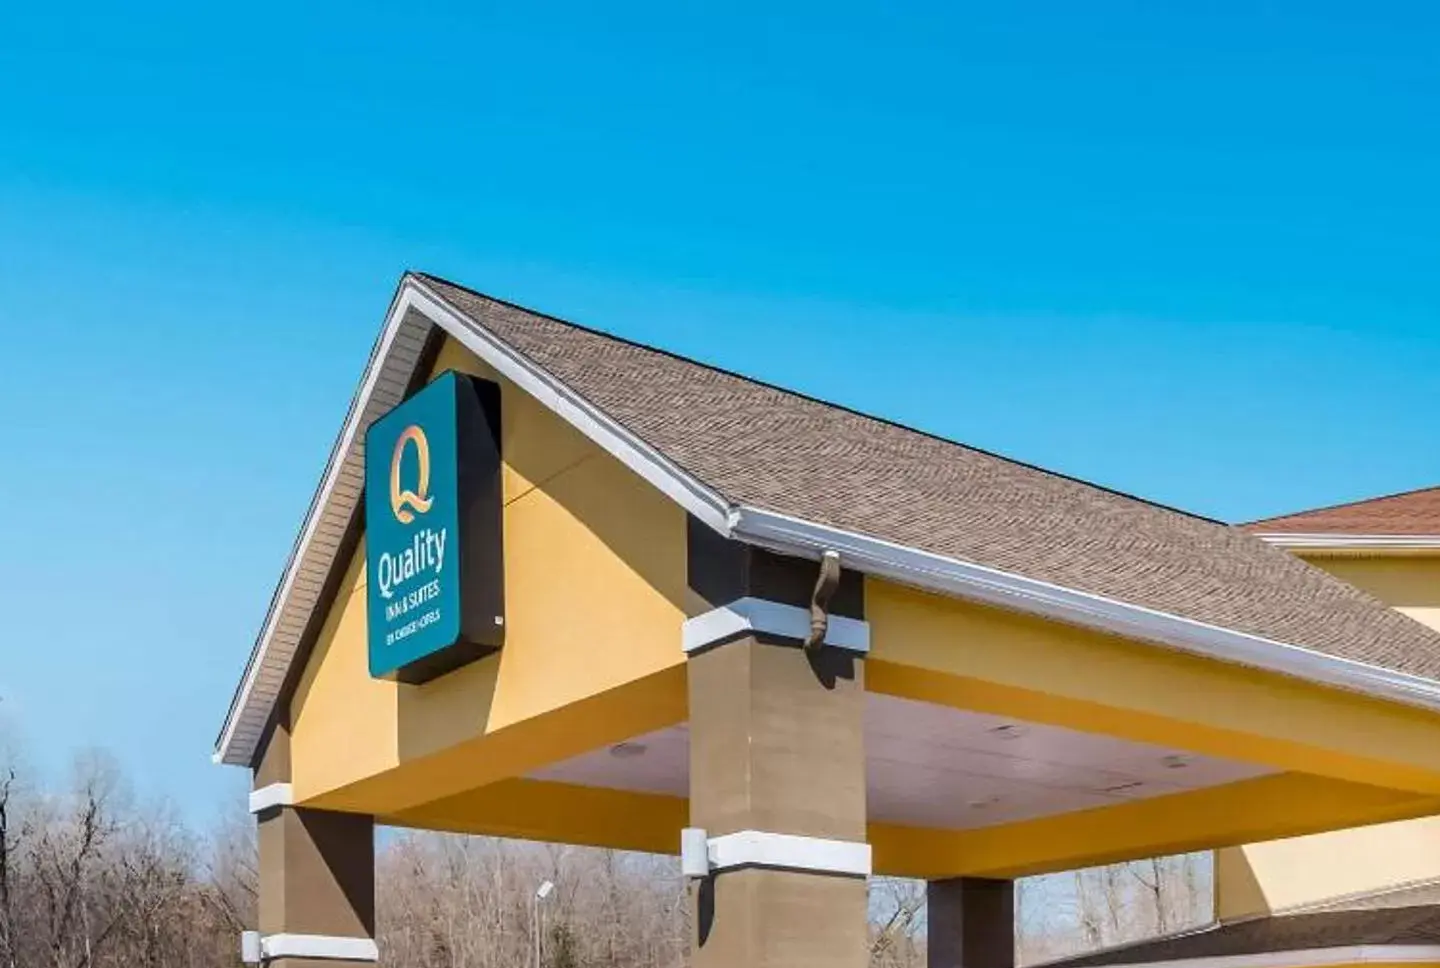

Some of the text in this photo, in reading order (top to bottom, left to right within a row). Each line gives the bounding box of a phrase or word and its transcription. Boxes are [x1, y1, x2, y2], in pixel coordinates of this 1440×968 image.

[390, 424, 435, 525] Q
[378, 527, 447, 599] Quality
[408, 578, 441, 610] SUITES
